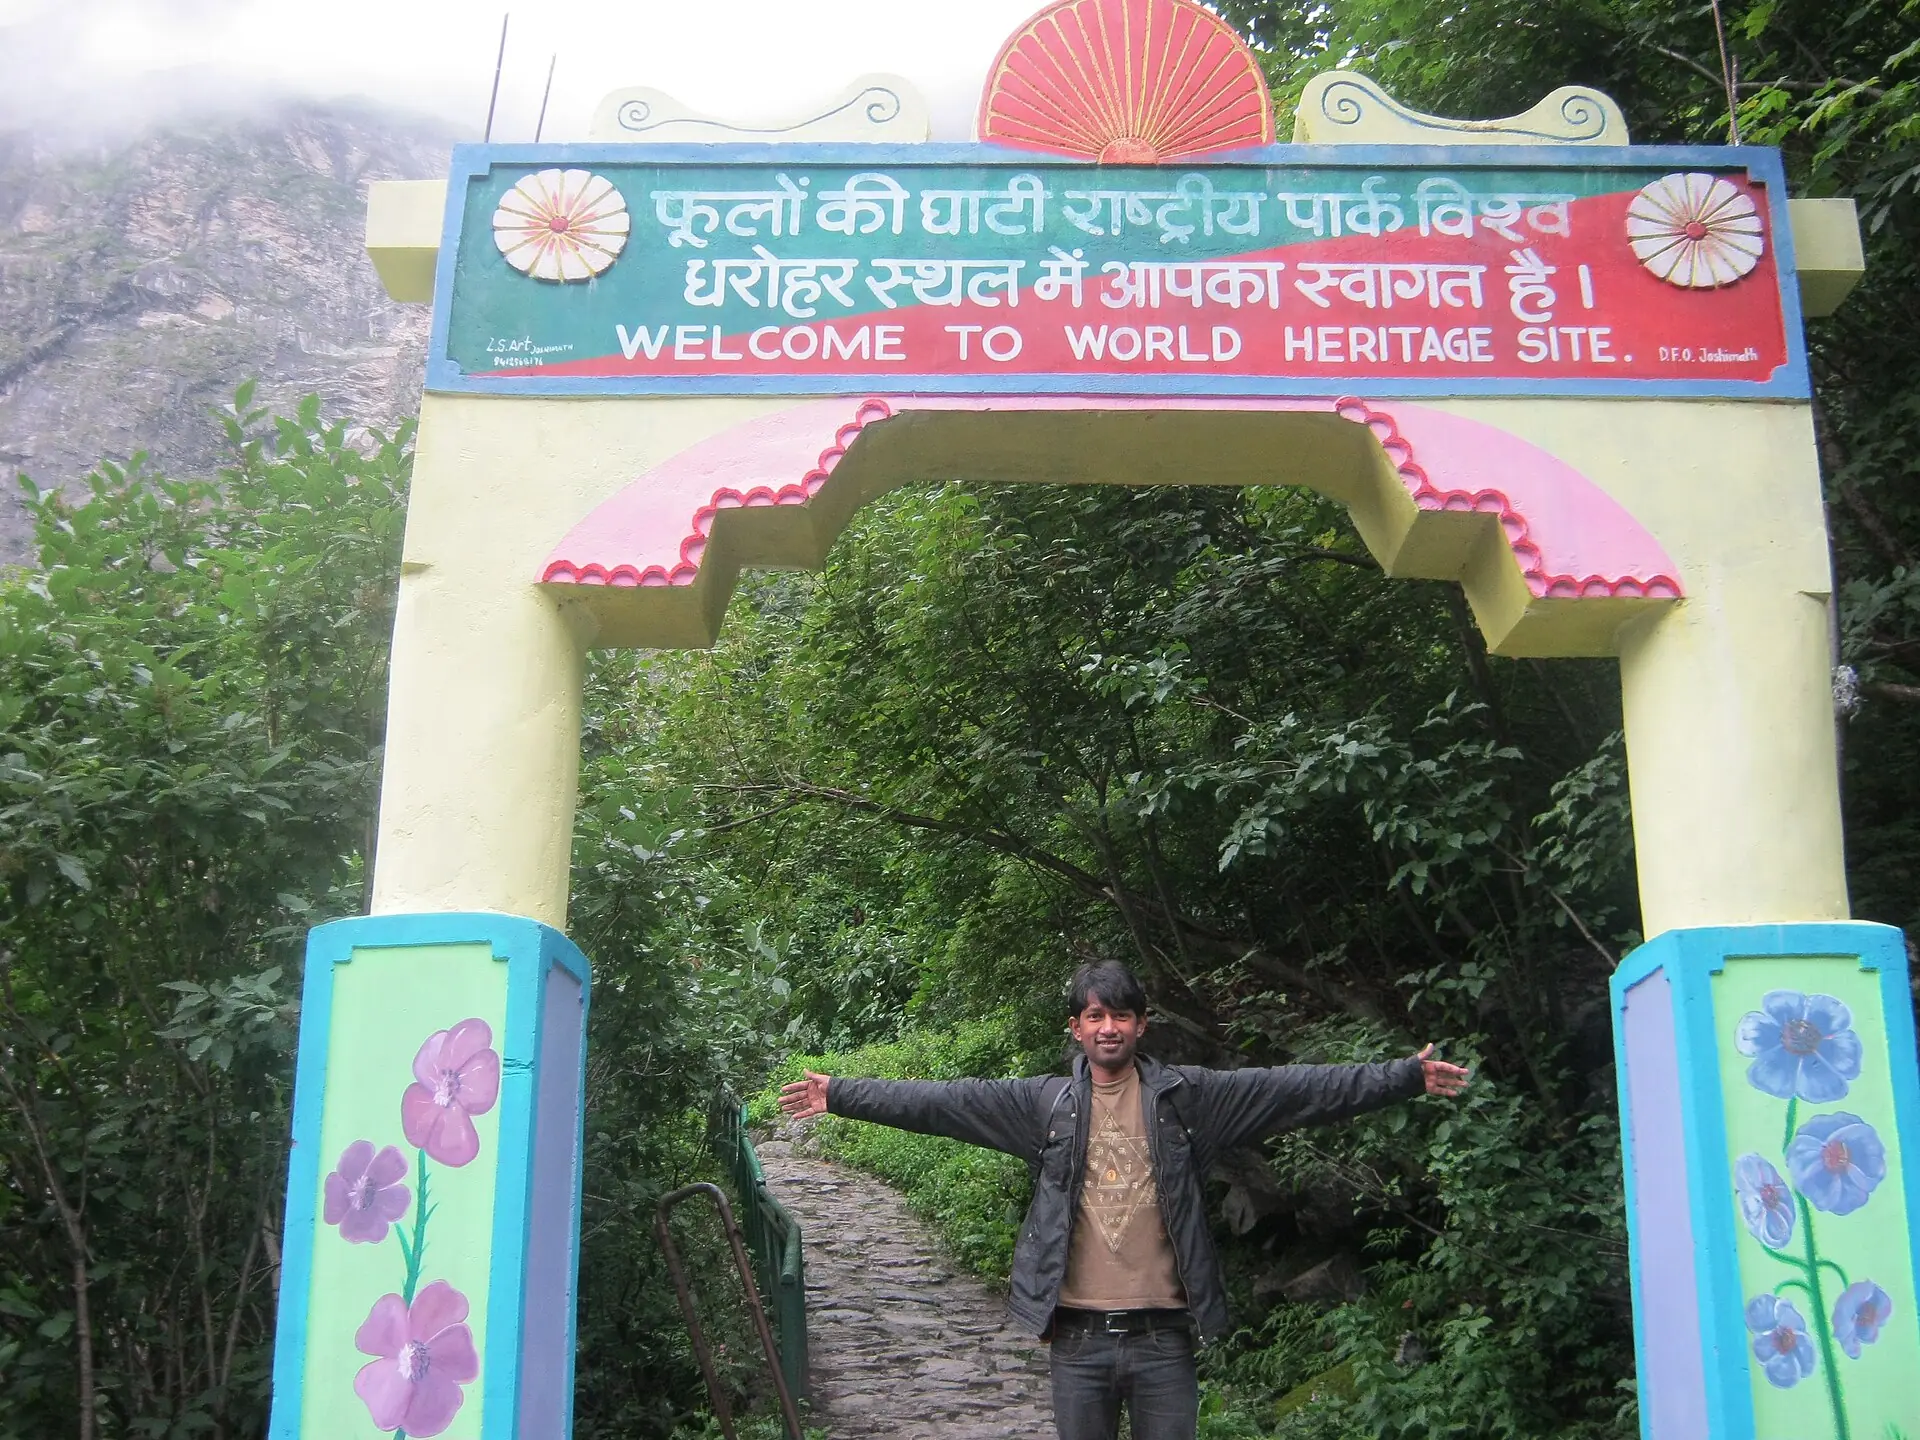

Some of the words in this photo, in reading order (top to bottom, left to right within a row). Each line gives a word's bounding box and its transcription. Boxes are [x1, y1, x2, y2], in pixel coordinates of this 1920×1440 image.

[650, 173, 810, 247] फूलों
[816, 173, 910, 234] की
[920, 174, 1052, 235] घाटी
[1062, 173, 1267, 244] राष्ट्रीय
[1278, 176, 1404, 237] पार्क
[1410, 177, 1576, 242] विश्व
[684, 244, 858, 318] धरोहर
[865, 258, 1026, 308] स्थल
[1034, 245, 1090, 308] में
[1100, 261, 1286, 309] आपका
[1294, 262, 1487, 308] स्वागत
[615, 325, 906, 361] WELCOME
[945, 325, 1022, 361] TO
[1064, 325, 1242, 362] WORLD
[1284, 326, 1494, 363] HERITAGE
[1517, 327, 1633, 363] SITE.
[1659, 346, 1695, 362] D.F.O.
[1699, 347, 1758, 362] Joshimath
